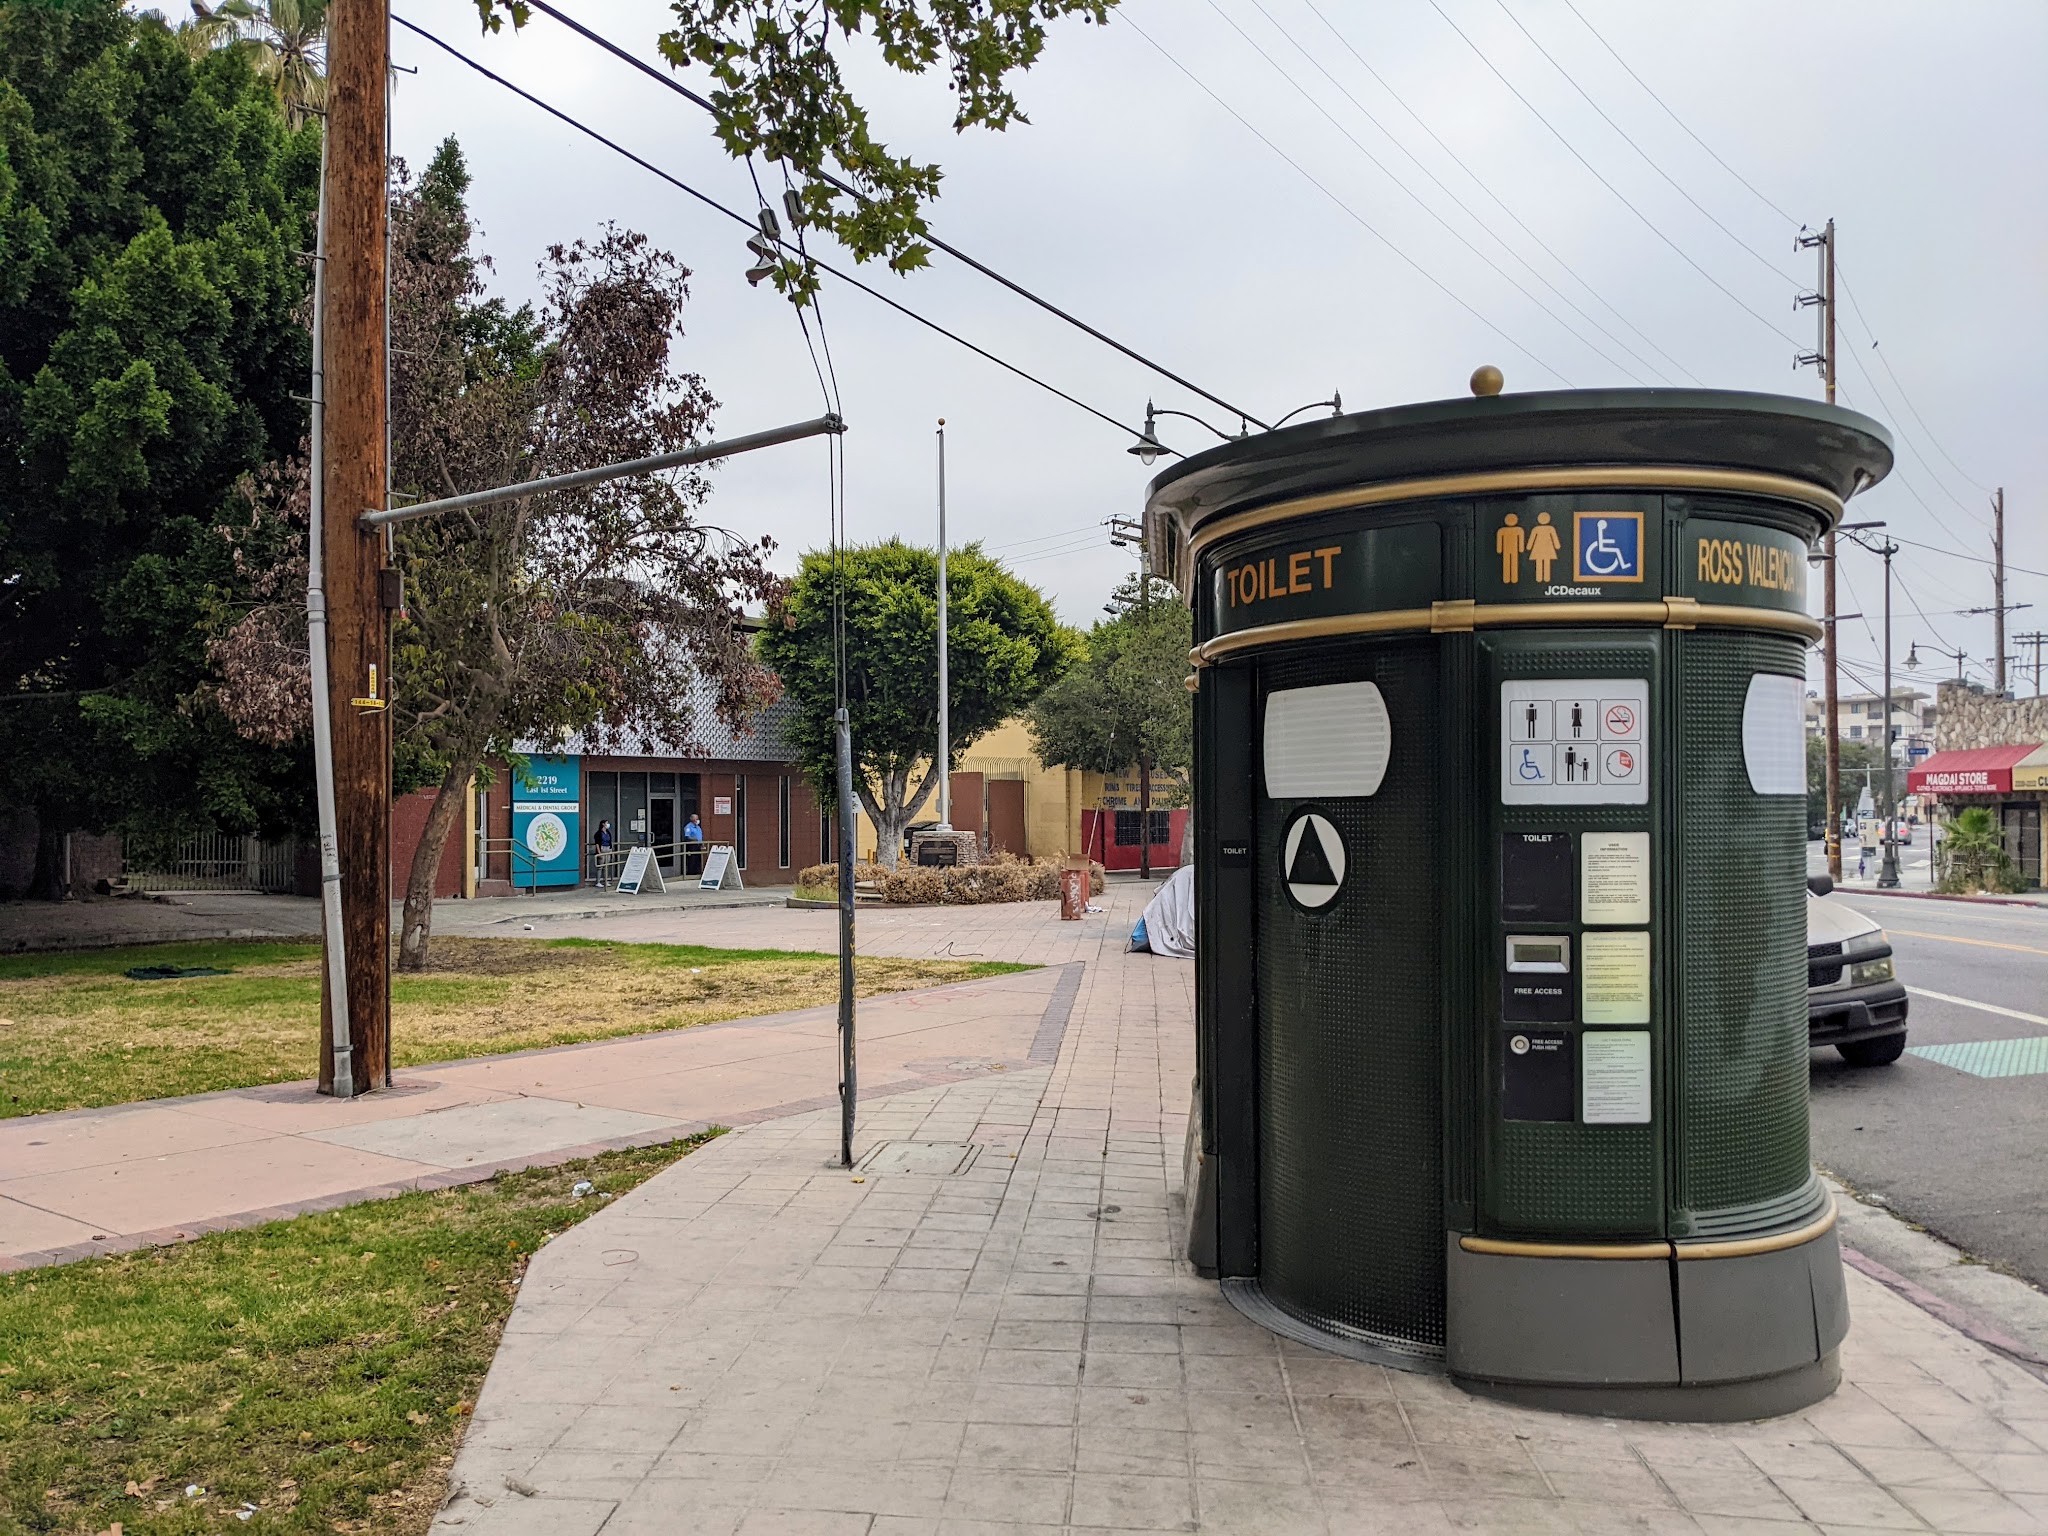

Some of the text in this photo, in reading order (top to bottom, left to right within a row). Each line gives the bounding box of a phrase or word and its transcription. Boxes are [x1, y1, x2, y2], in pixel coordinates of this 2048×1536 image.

[1698, 538, 1743, 585] ROSS
[1746, 543, 1796, 592] VALENCIA
[1227, 546, 1342, 608] TOILET
[1544, 585, 1601, 596] JCDecaux
[537, 775, 558, 785] 2219
[1959, 772, 1988, 784] STORE
[1104, 783, 1120, 791] RIMS
[1103, 797, 1127, 806] CHROME
[1522, 834, 1553, 842] TOILET
